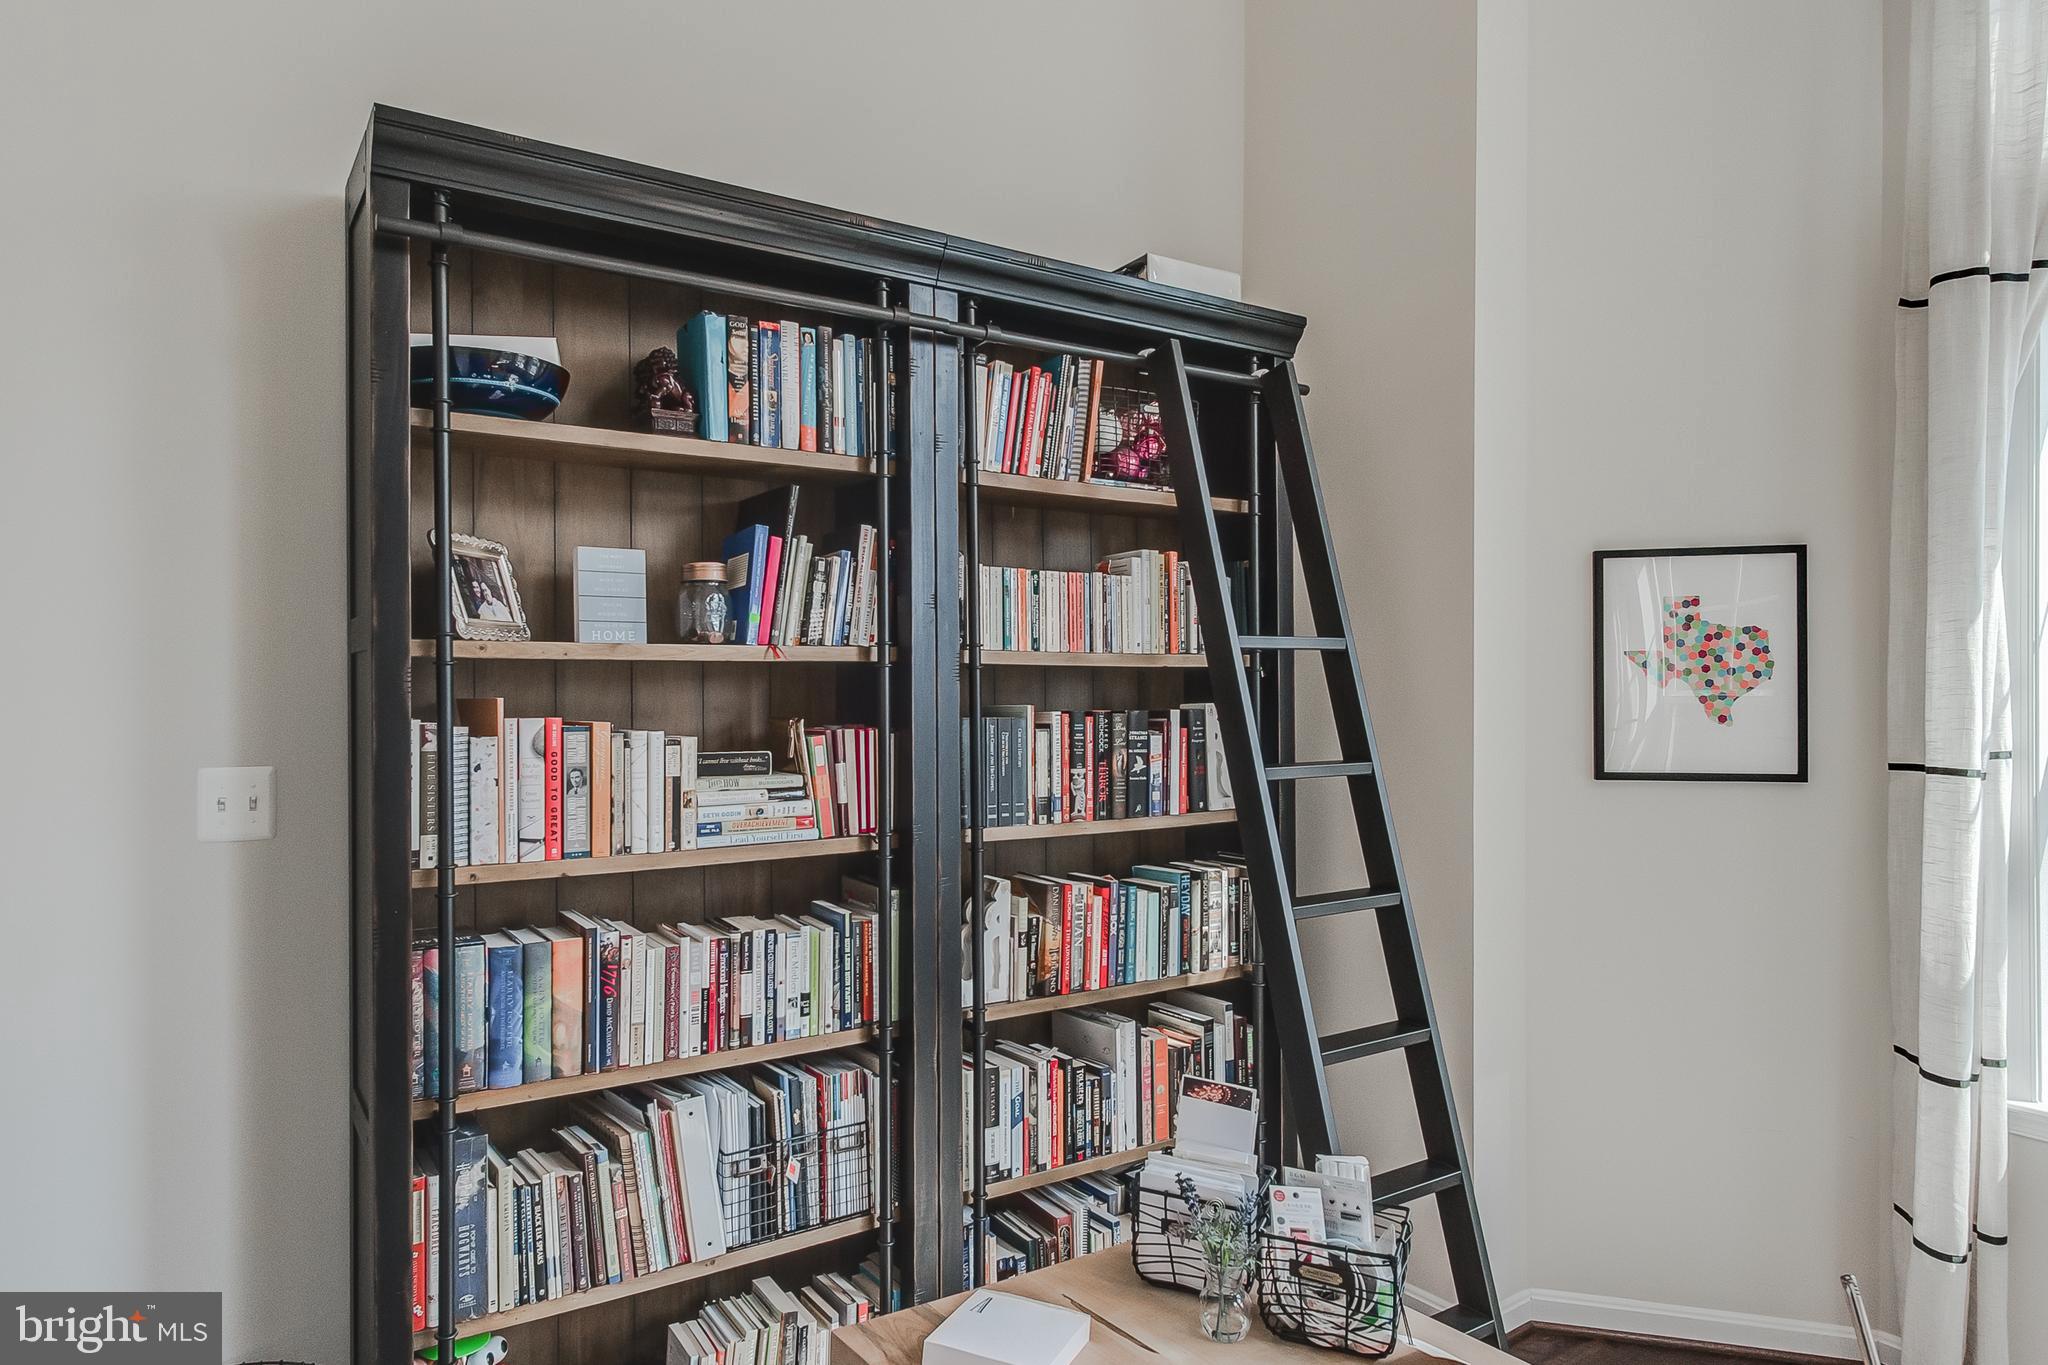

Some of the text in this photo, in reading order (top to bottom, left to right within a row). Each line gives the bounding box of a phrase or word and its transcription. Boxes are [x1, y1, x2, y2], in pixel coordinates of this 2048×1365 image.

[1024, 371, 1040, 461] LENCIONI THE ADVANTAGE
[592, 630, 636, 641] HOME
[427, 754, 437, 832] FIVE SISTERS
[551, 788, 558, 801] TO
[723, 778, 741, 788] HOW
[730, 832, 805, 844] Lead Yourself First
[731, 820, 789, 830] OVERACHIEVEMENT
[1051, 886, 1059, 906] DAN
[1180, 874, 1190, 916] HEYDAY
[1202, 900, 1209, 910] OF
[1074, 902, 1084, 947] TITAN
[1110, 914, 1118, 936] BOX
[601, 964, 618, 998] 1776
[790, 941, 799, 995] First Mothers
[1049, 948, 1060, 993] INFERNO
[718, 953, 728, 1014] Emotional Intelligence
[606, 998, 614, 1016] DAVID
[692, 1013, 700, 1026] LAST
[1076, 1068, 1085, 1105] TOLKIEN'S
[589, 1172, 598, 1203] ORCHARD
[432, 1208, 440, 1256] FRACTURED
[458, 1224, 471, 1279] HOGWARTS
[536, 1241, 544, 1265] SPEAKS
[470, 1266, 476, 1274] TO
